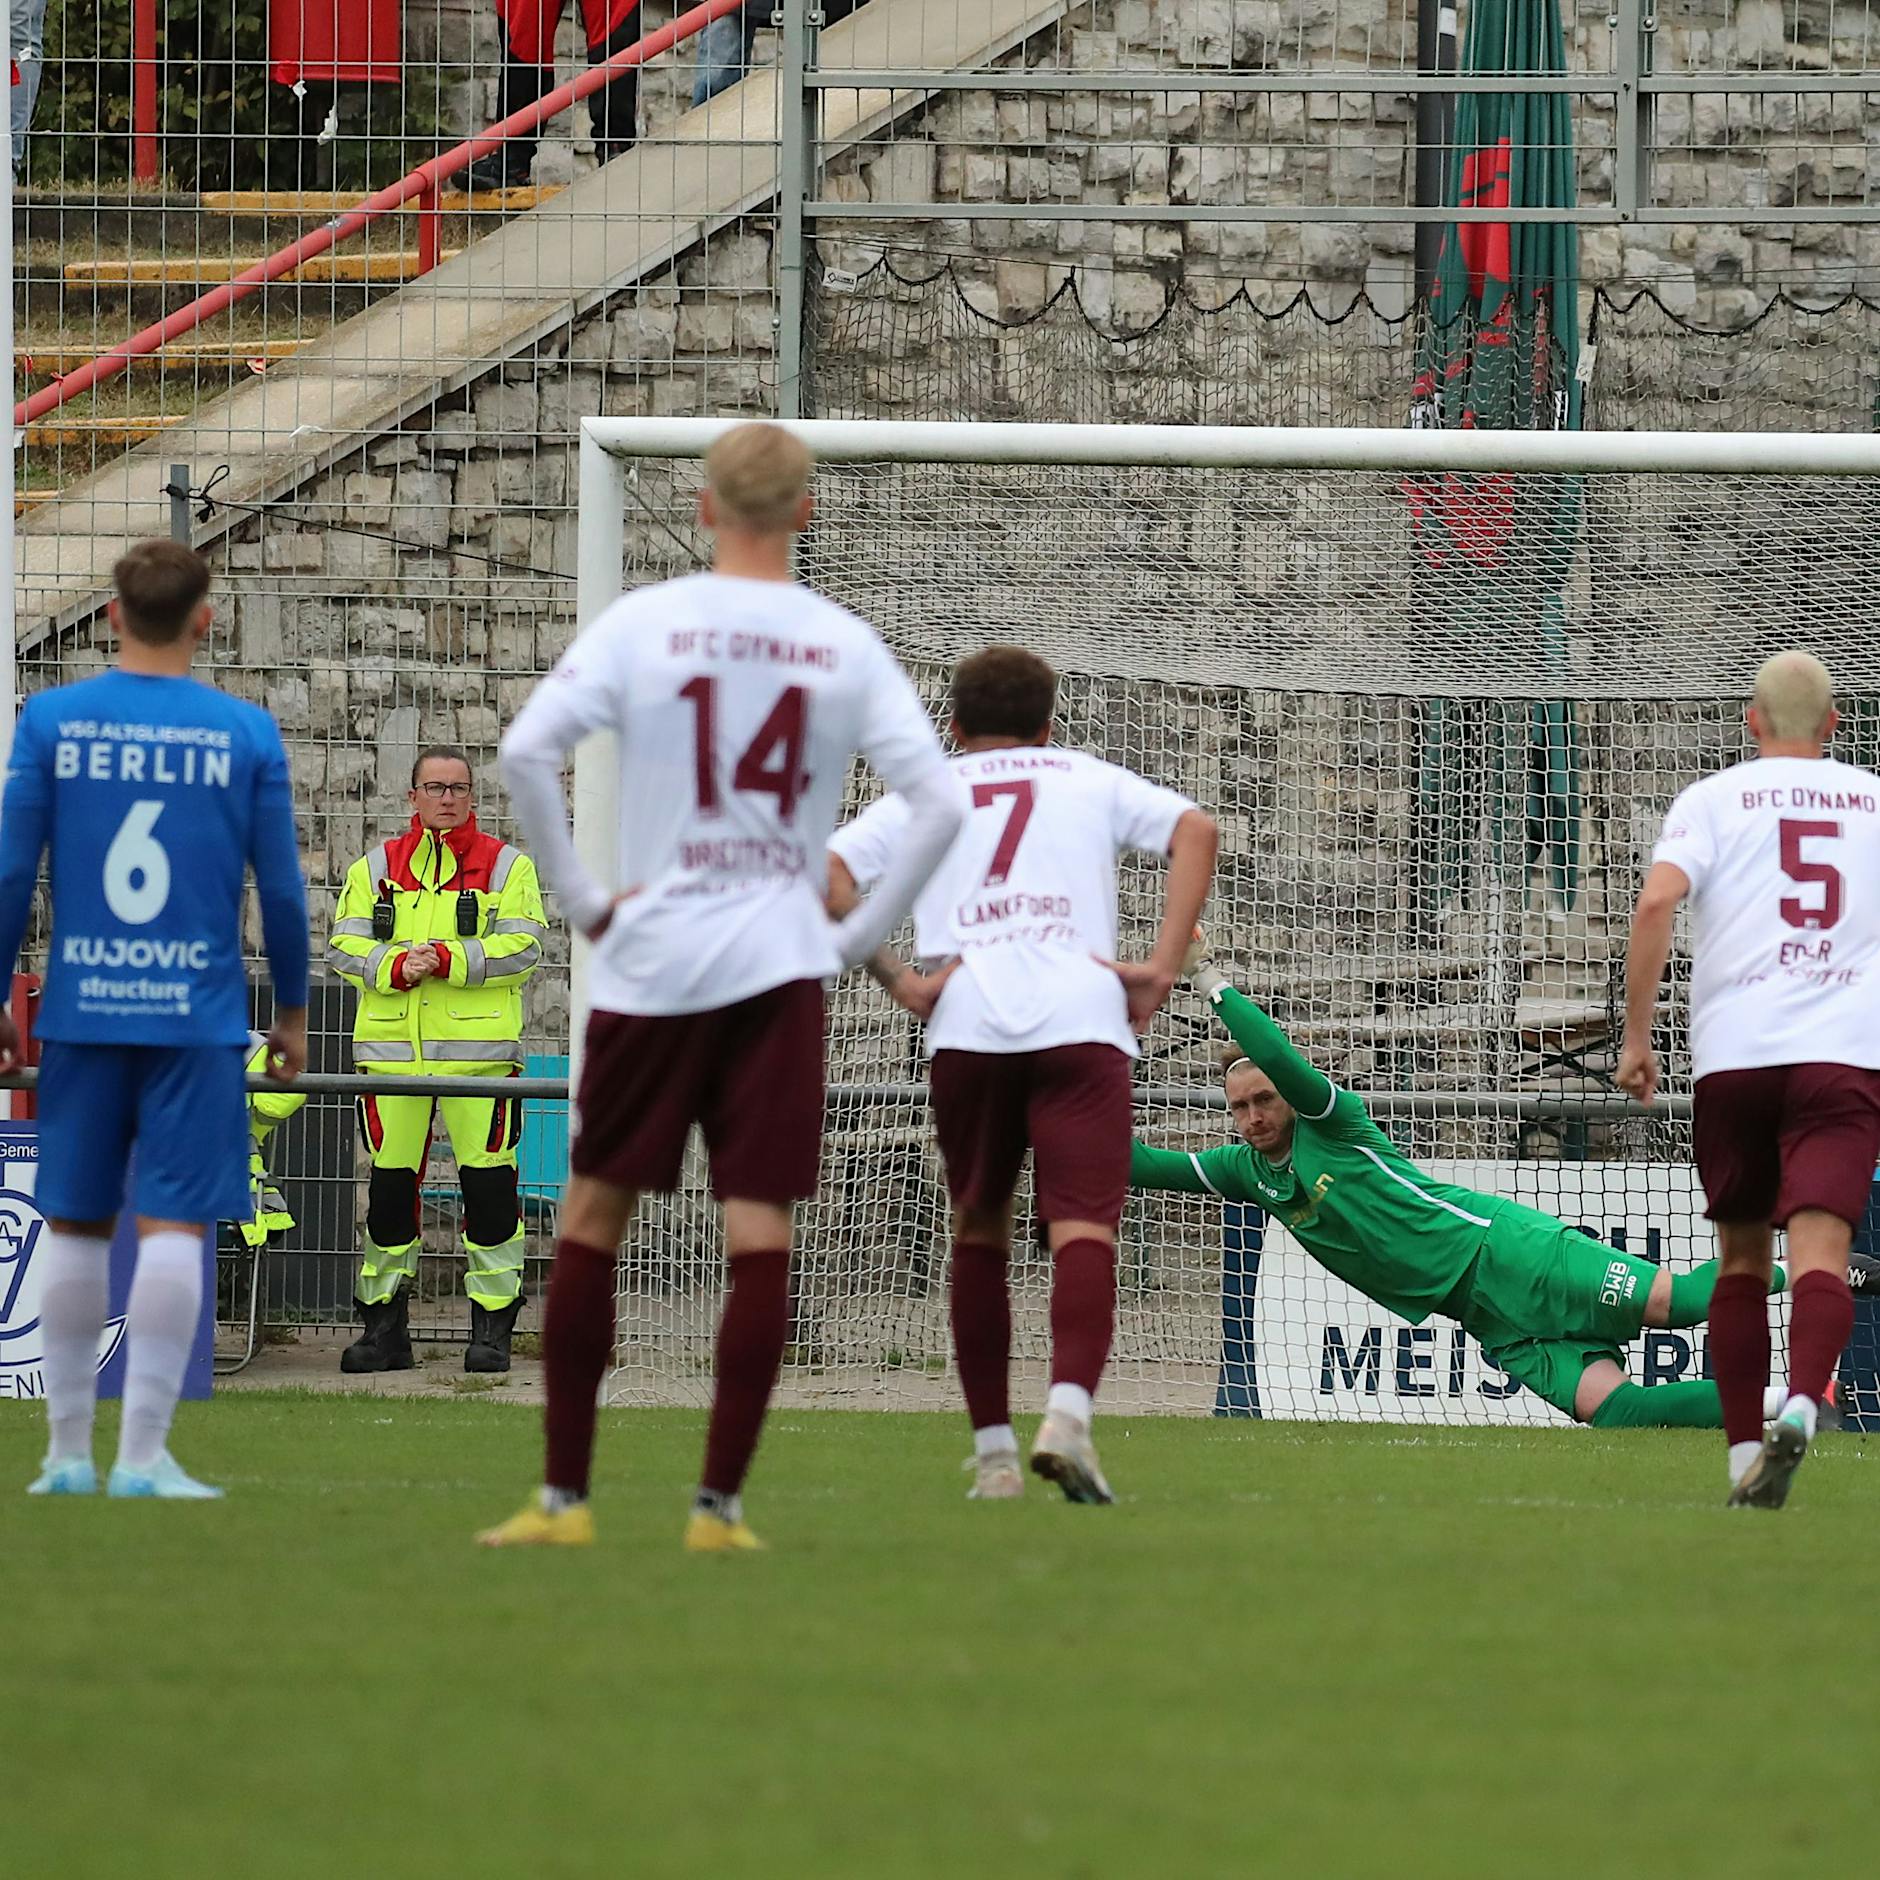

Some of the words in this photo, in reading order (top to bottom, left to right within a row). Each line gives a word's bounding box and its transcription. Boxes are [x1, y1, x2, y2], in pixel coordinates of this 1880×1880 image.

[667, 628, 720, 659] BFC
[729, 630, 839, 673] DYNAMO
[58, 720, 98, 739] VSG
[100, 721, 232, 749] ALTGLIENICKE
[678, 676, 813, 828] 14
[54, 741, 232, 788] BERLIN
[981, 757, 1073, 774] DYNAMO
[1741, 789, 1784, 810] BFC
[1791, 787, 1876, 813] DYNAMO
[972, 779, 1037, 888] 7
[103, 799, 171, 925] 6
[1779, 817, 1845, 930] 5
[958, 892, 1072, 927] LANKFORD
[62, 935, 210, 970] KUJOVIC
[77, 975, 191, 1001] structure
[1601, 1261, 1627, 1307] DWB
[1624, 1275, 1637, 1299] JAKO
